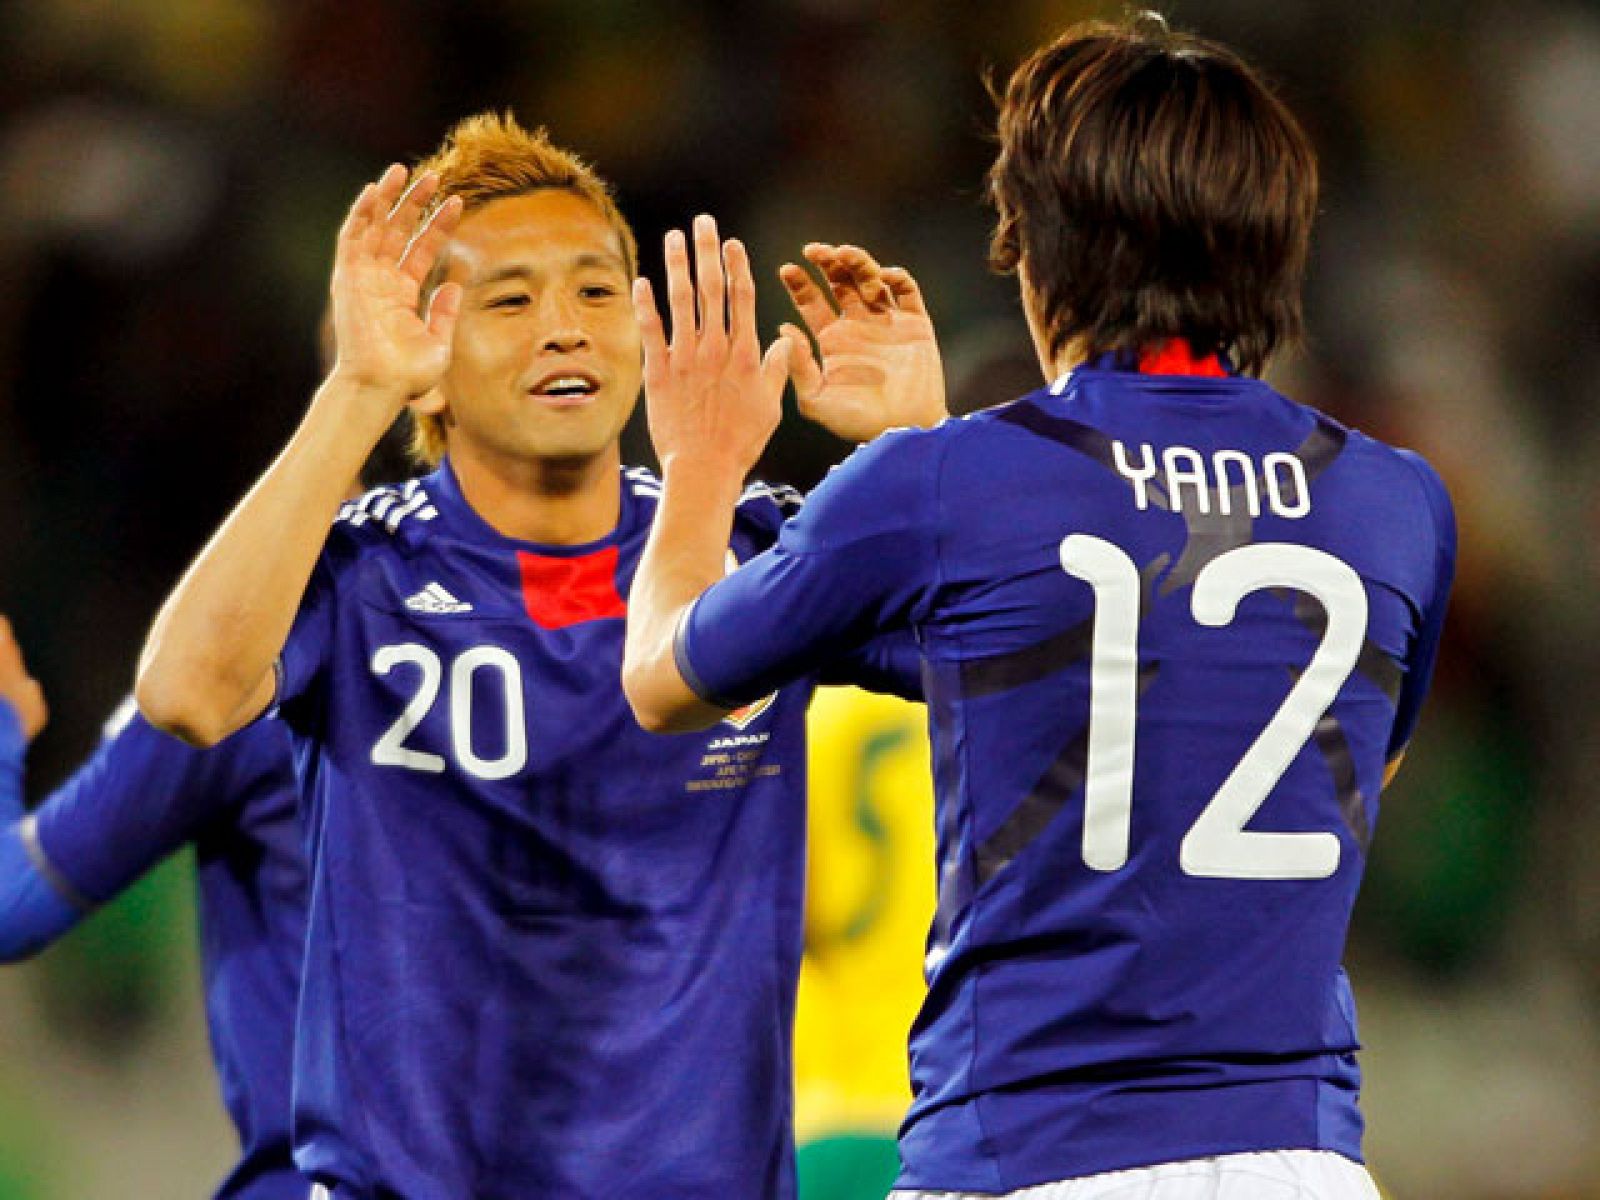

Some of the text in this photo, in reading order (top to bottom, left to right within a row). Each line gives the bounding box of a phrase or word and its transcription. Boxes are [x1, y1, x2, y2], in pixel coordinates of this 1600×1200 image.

[1110, 438, 1312, 520] YANO
[369, 643, 528, 780] 20
[1058, 533, 1369, 880] 12
